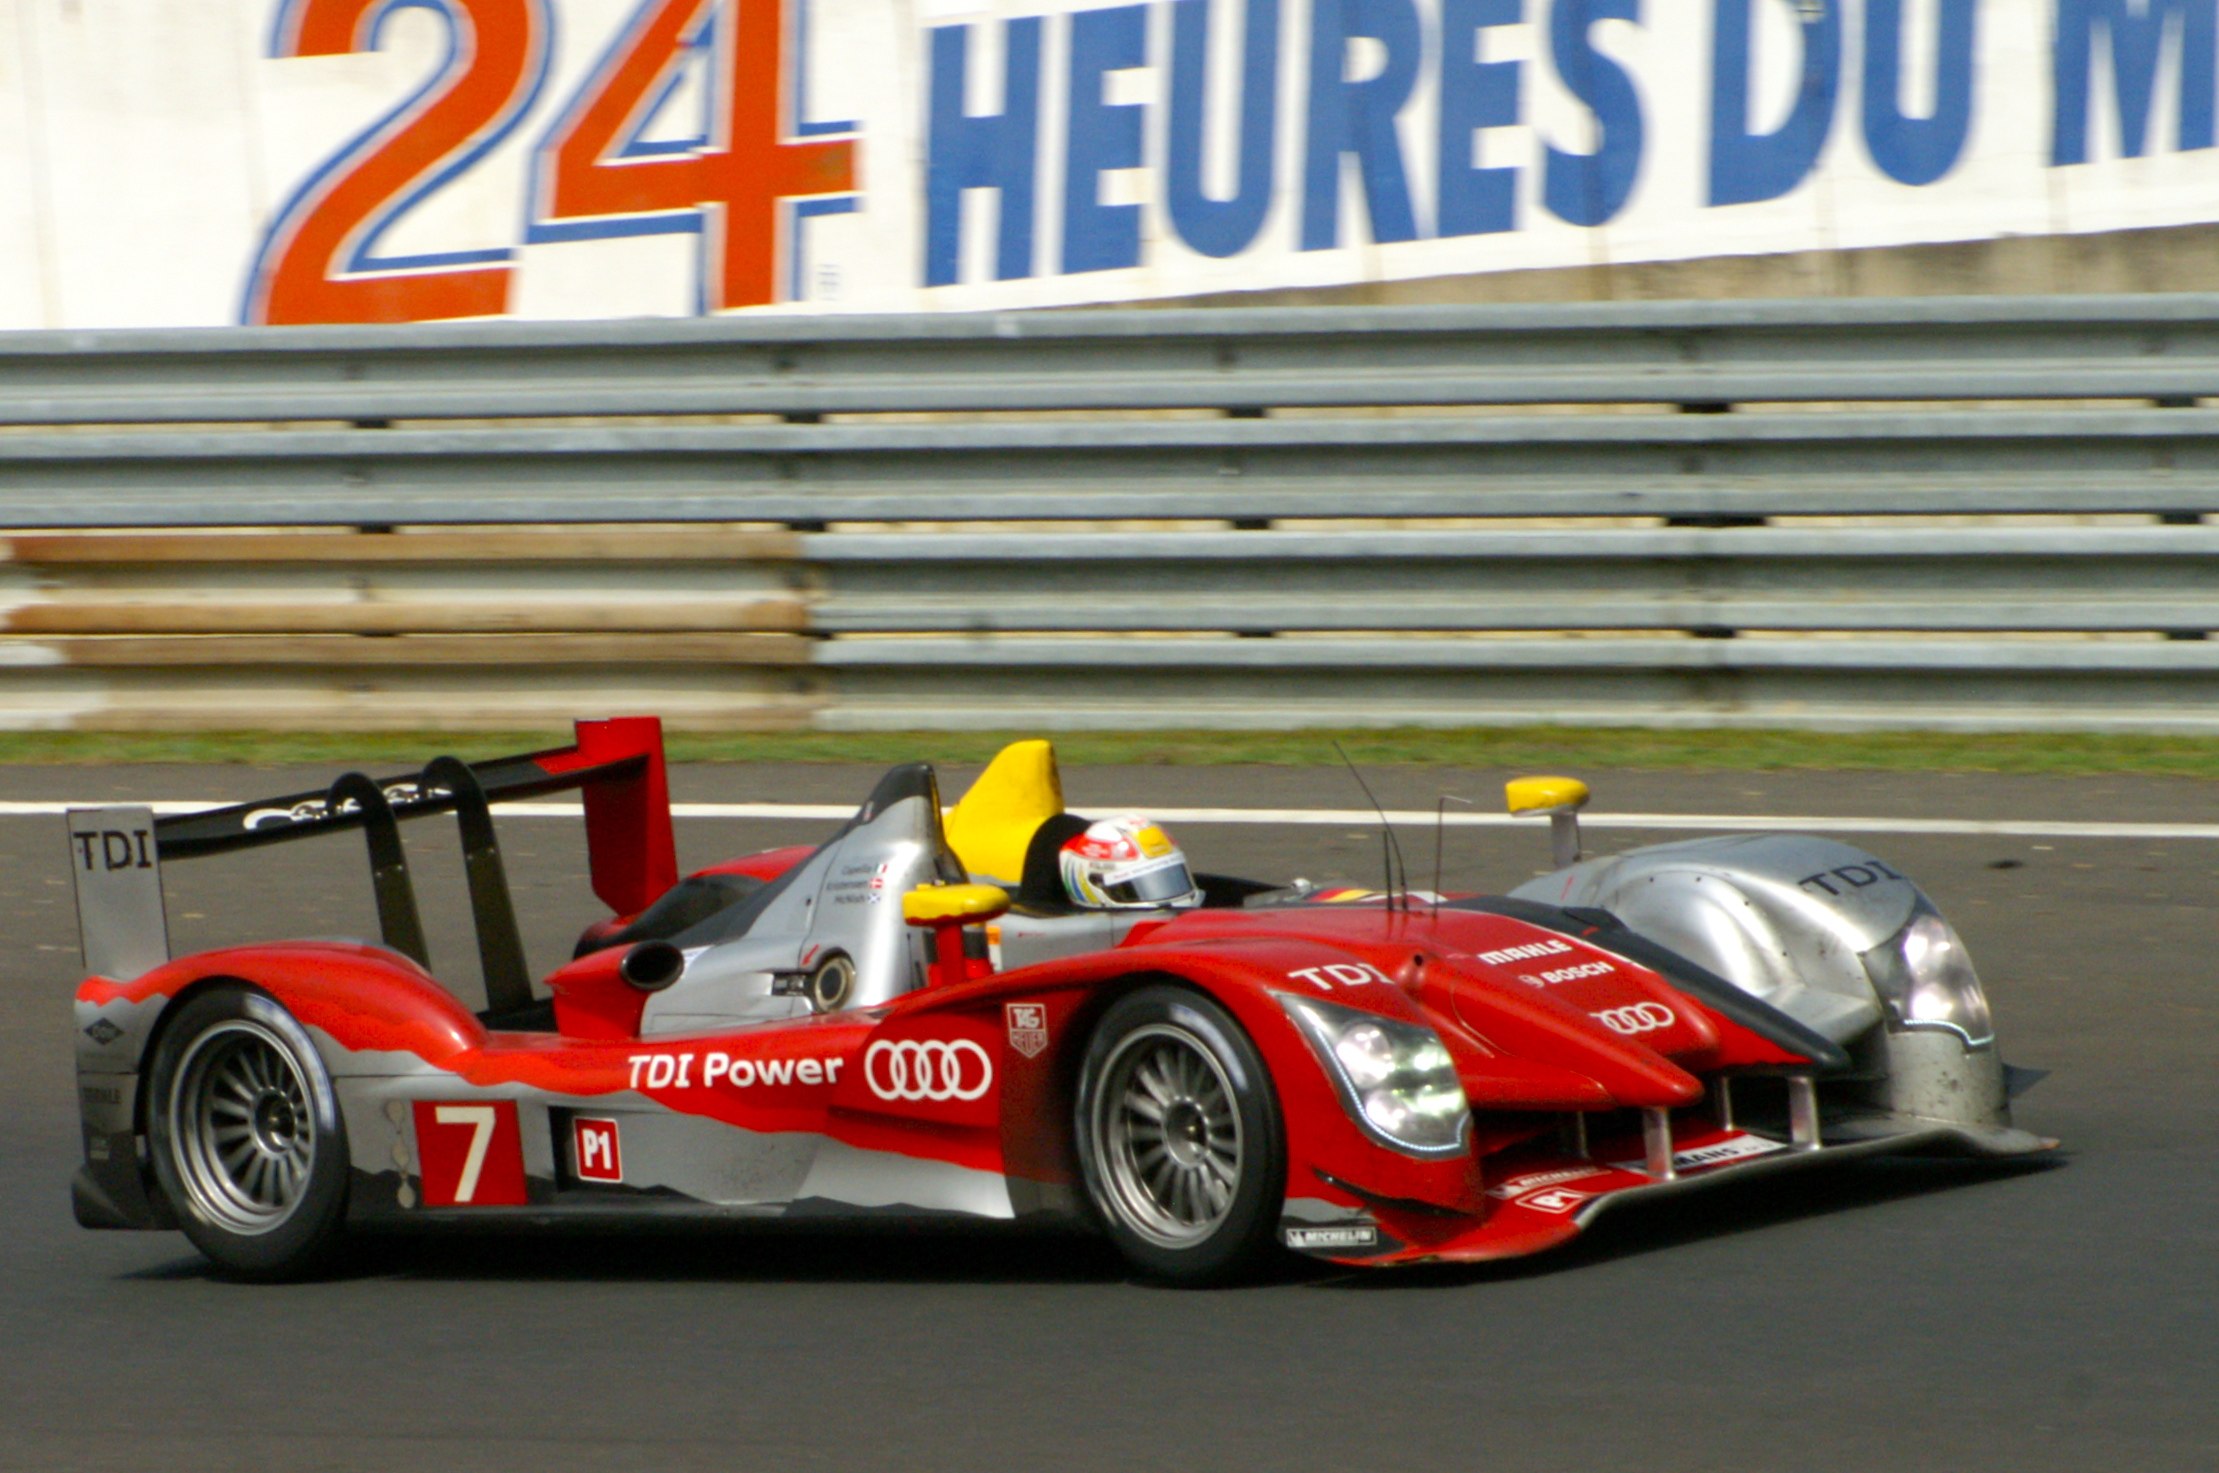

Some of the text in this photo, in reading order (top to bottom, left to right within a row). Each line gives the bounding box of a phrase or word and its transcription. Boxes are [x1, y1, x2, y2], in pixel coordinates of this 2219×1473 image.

[239, 0, 864, 326] 24
[917, 0, 1651, 288] HEURES
[1699, 0, 1977, 208] DU
[73, 829, 152, 871] TDI
[1798, 861, 1902, 896] TDI
[1477, 939, 1574, 965] MAHLE
[1287, 962, 1395, 990] TDI
[1540, 961, 1616, 983] BOSCH
[1013, 1007, 1040, 1028] TAG
[627, 1052, 845, 1089] TDI Power
[435, 1106, 496, 1202] 7
[582, 1128, 613, 1170] P1
[1305, 1229, 1372, 1241] MICHELIN
